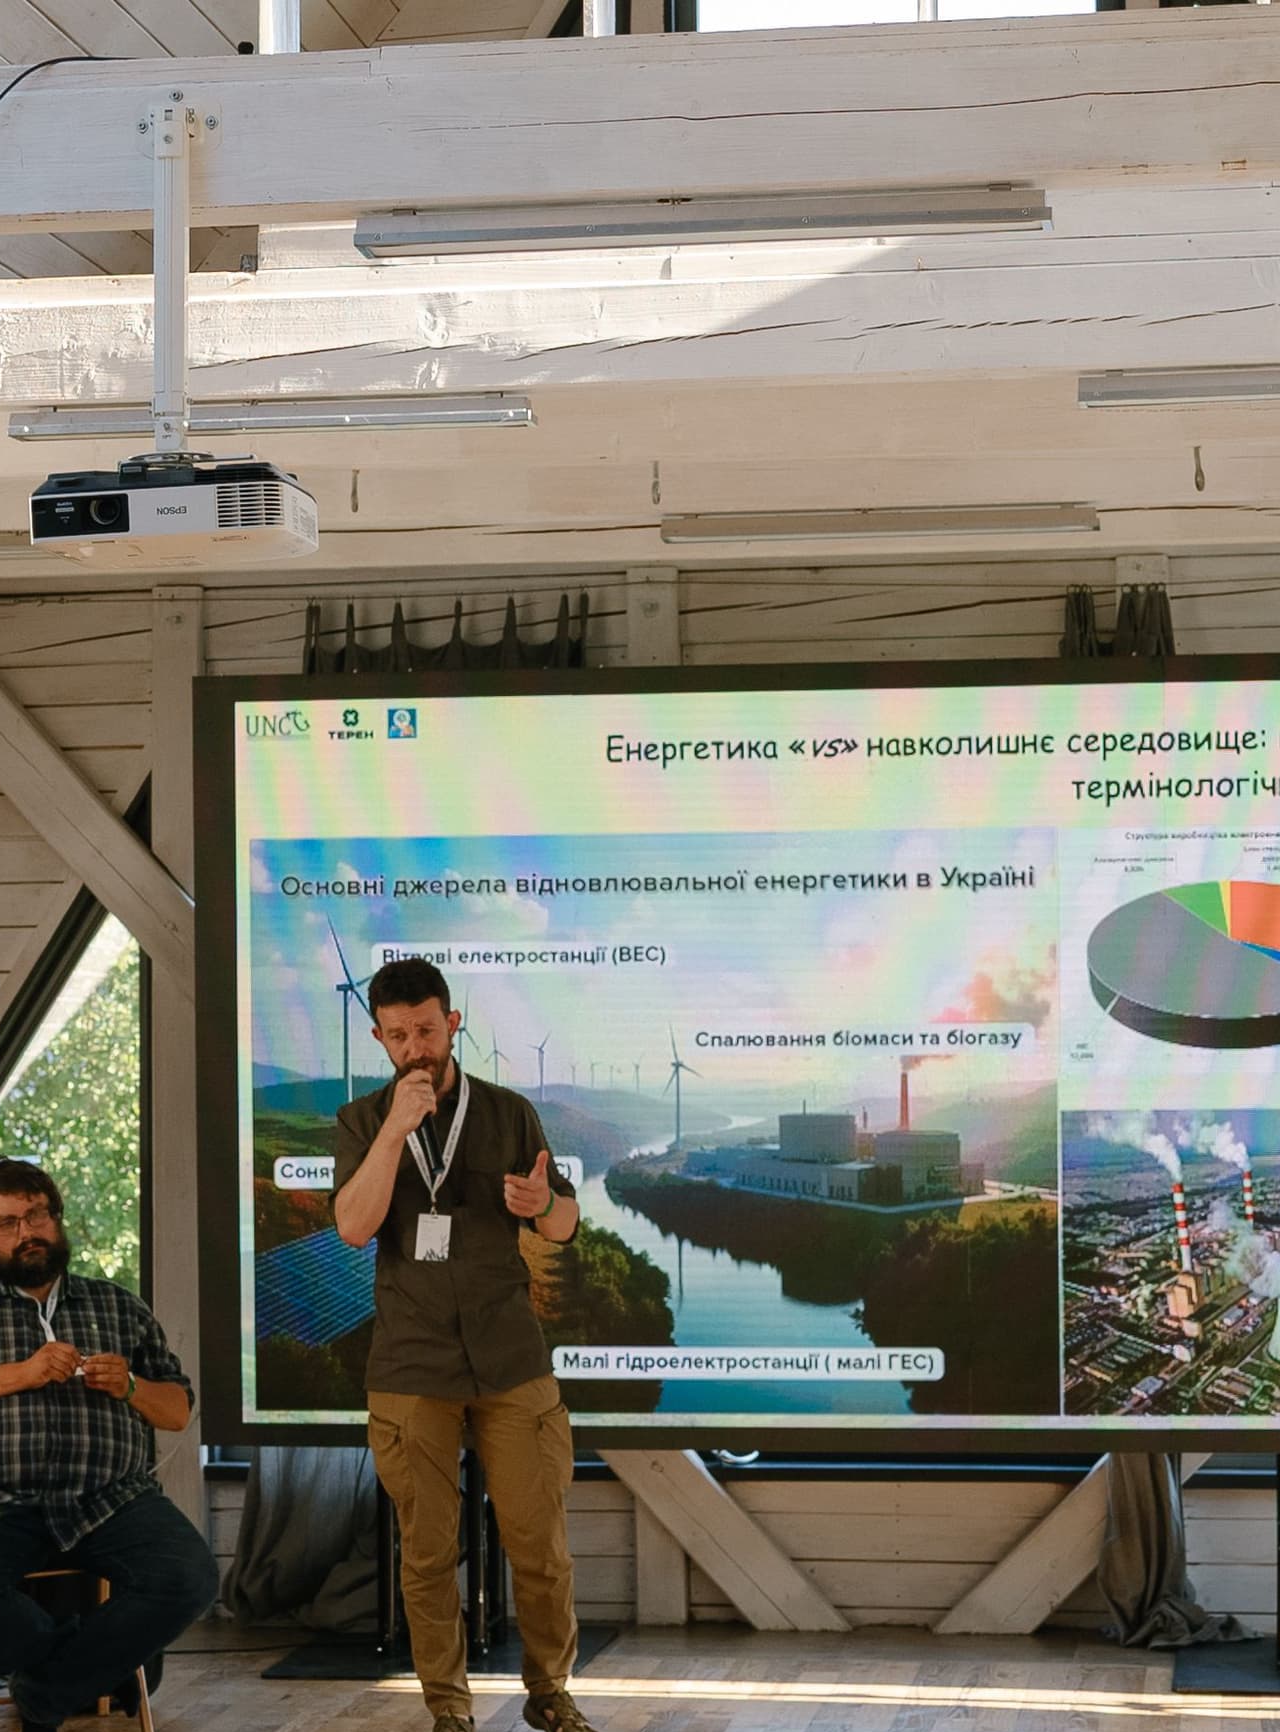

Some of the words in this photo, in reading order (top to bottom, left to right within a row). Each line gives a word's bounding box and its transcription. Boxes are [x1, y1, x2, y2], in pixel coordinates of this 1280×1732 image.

[156, 505, 187, 516] EPSON
[606, 734, 778, 769] Енергетика
[866, 732, 1055, 758] навколишнє
[1067, 728, 1267, 761] середовище:
[281, 875, 385, 897] Основні
[393, 876, 507, 898] джерела
[516, 869, 747, 896] відновлювальної
[754, 871, 908, 895] енергетики
[917, 873, 931, 888] в
[941, 865, 1035, 892] Україні
[458, 945, 607, 967] електростанції
[612, 945, 667, 966] (ВЕС)
[695, 1031, 827, 1048] Спалювання
[833, 1029, 915, 1047] біомаси
[920, 1033, 940, 1046] та
[946, 1029, 1023, 1049] біогазу
[562, 1352, 609, 1370] Малі
[616, 1352, 819, 1373] гідроелектростанції
[836, 1353, 882, 1370] малі
[888, 1354, 935, 1374] ГЕС)
